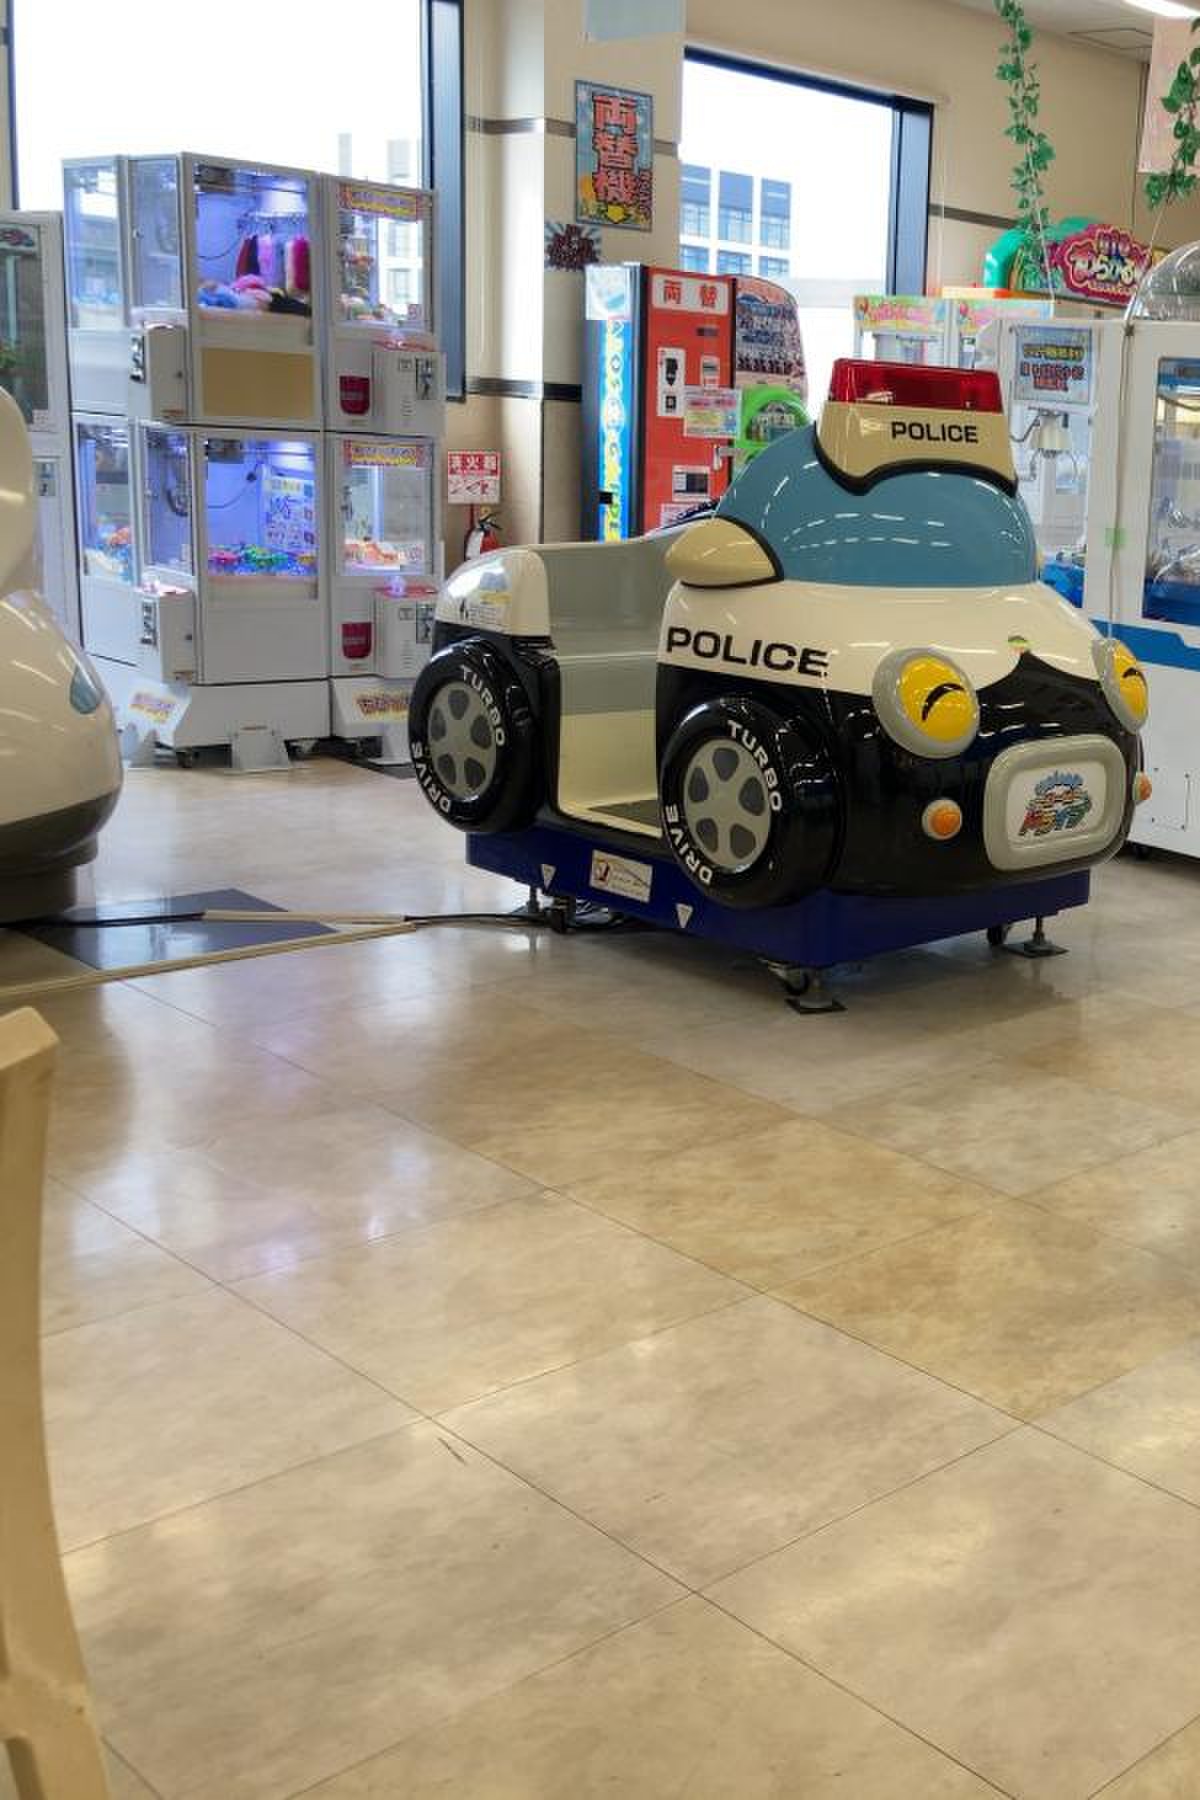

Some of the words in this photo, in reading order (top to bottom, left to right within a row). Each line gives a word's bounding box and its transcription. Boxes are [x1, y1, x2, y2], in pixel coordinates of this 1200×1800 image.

[592, 94, 640, 206] 両替機
[890, 421, 979, 444] POLICE
[666, 626, 829, 678] POLICE
[459, 664, 506, 747] TURBO
[411, 740, 451, 813] DRIVE
[727, 719, 783, 812] TURBO
[665, 803, 714, 886] DRIVE
